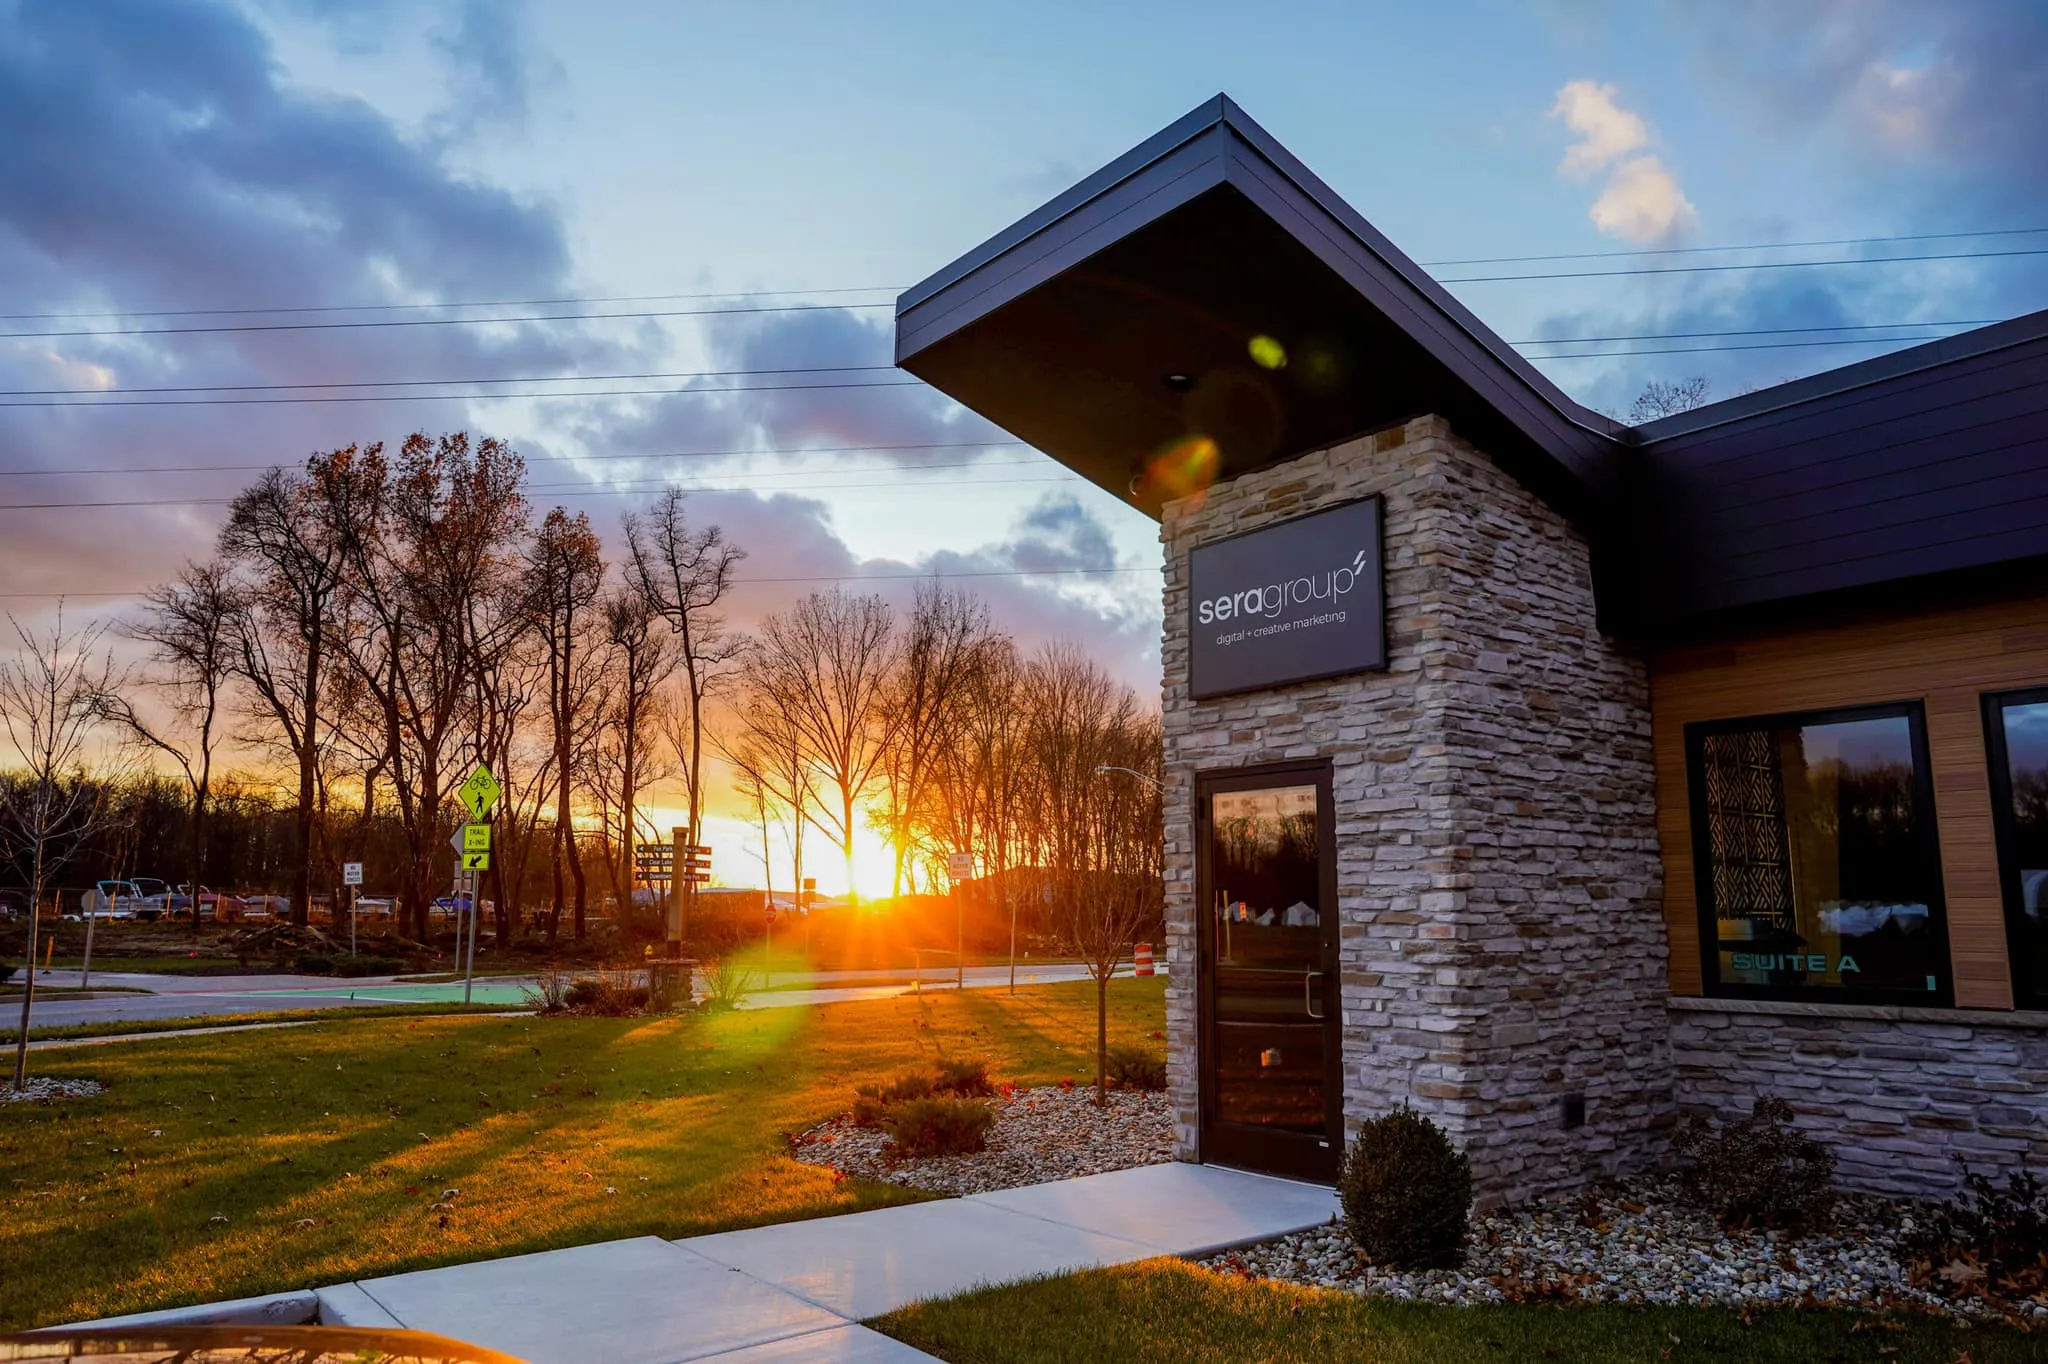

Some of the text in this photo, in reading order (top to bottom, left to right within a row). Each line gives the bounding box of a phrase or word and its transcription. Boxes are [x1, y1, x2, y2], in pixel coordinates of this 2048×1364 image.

[1199, 567, 1354, 624] seragroup
[1216, 630, 1245, 645] digital
[1253, 622, 1291, 637] creative
[1293, 611, 1346, 629] marketing
[1732, 953, 1861, 973] SUITE A
